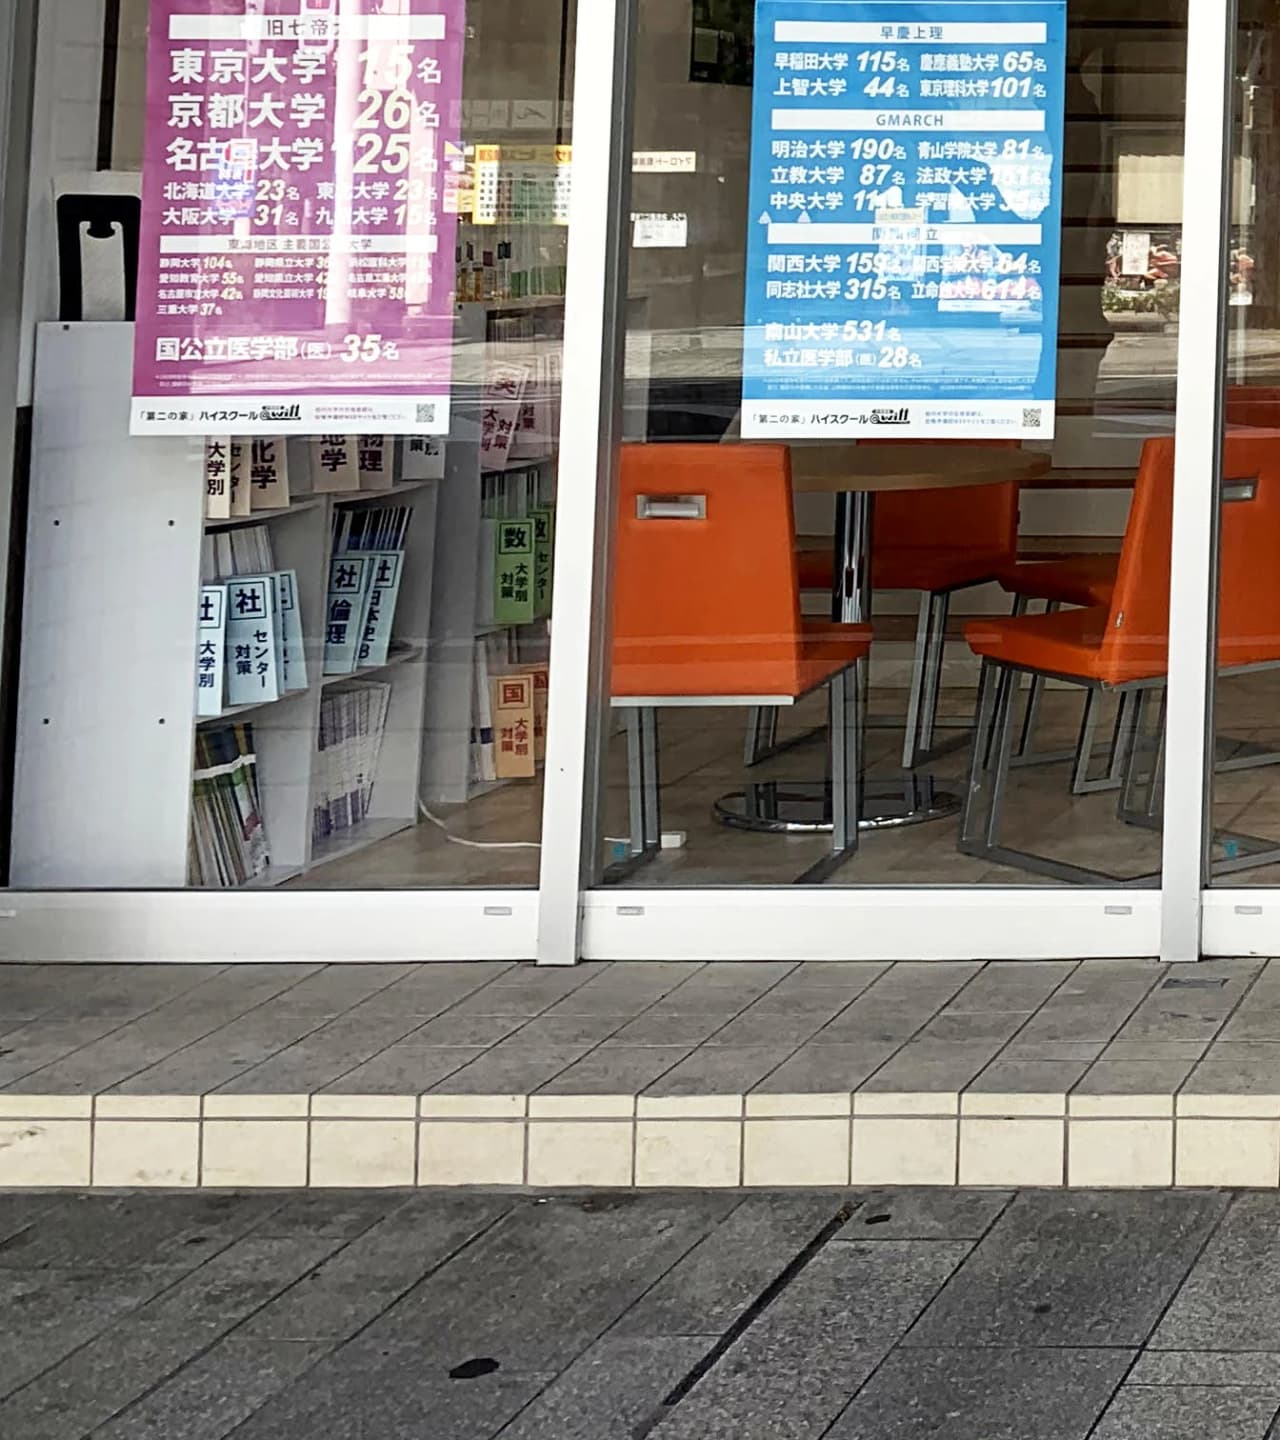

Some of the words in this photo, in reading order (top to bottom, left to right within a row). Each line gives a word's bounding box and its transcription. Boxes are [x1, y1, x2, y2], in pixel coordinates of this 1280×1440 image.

[168, 47, 327, 84] 東京大学
[773, 51, 849, 72] 早稲田大学
[856, 50, 910, 72] 115名
[1002, 50, 1047, 73] 65名
[773, 77, 847, 98] 上智大学
[862, 76, 909, 98] 44名
[990, 76, 1047, 99] 101名
[166, 91, 326, 129] 京都大学
[353, 88, 440, 130] 26名
[876, 113, 944, 127] GMARCH
[771, 139, 846, 159] 明治大学
[850, 138, 907, 160] 190名
[917, 140, 998, 161] 青山学院大学
[1001, 138, 1046, 161] 81名
[770, 165, 845, 185] 立教大学
[858, 163, 906, 186] 87名
[915, 165, 988, 186] 法政大学
[254, 179, 301, 201] 23名
[769, 191, 844, 211] 中央大学
[253, 204, 300, 226] 31名
[766, 253, 842, 274] 関西大学
[765, 280, 842, 300] 同志社大学
[844, 278, 901, 300] 315名
[842, 320, 902, 342] 531名
[339, 333, 401, 363] 35名
[878, 346, 922, 369] 28名
[206, 441, 226, 496] 大学別
[250, 440, 277, 490] 化学
[503, 527, 527, 549] 数
[335, 564, 357, 589] 社
[235, 588, 262, 614] 社
[325, 599, 353, 645] 倫理
[198, 639, 216, 688] 大学別
[234, 643, 252, 675] 対策
[253, 629, 269, 688] センター
[502, 683, 525, 704] 国
